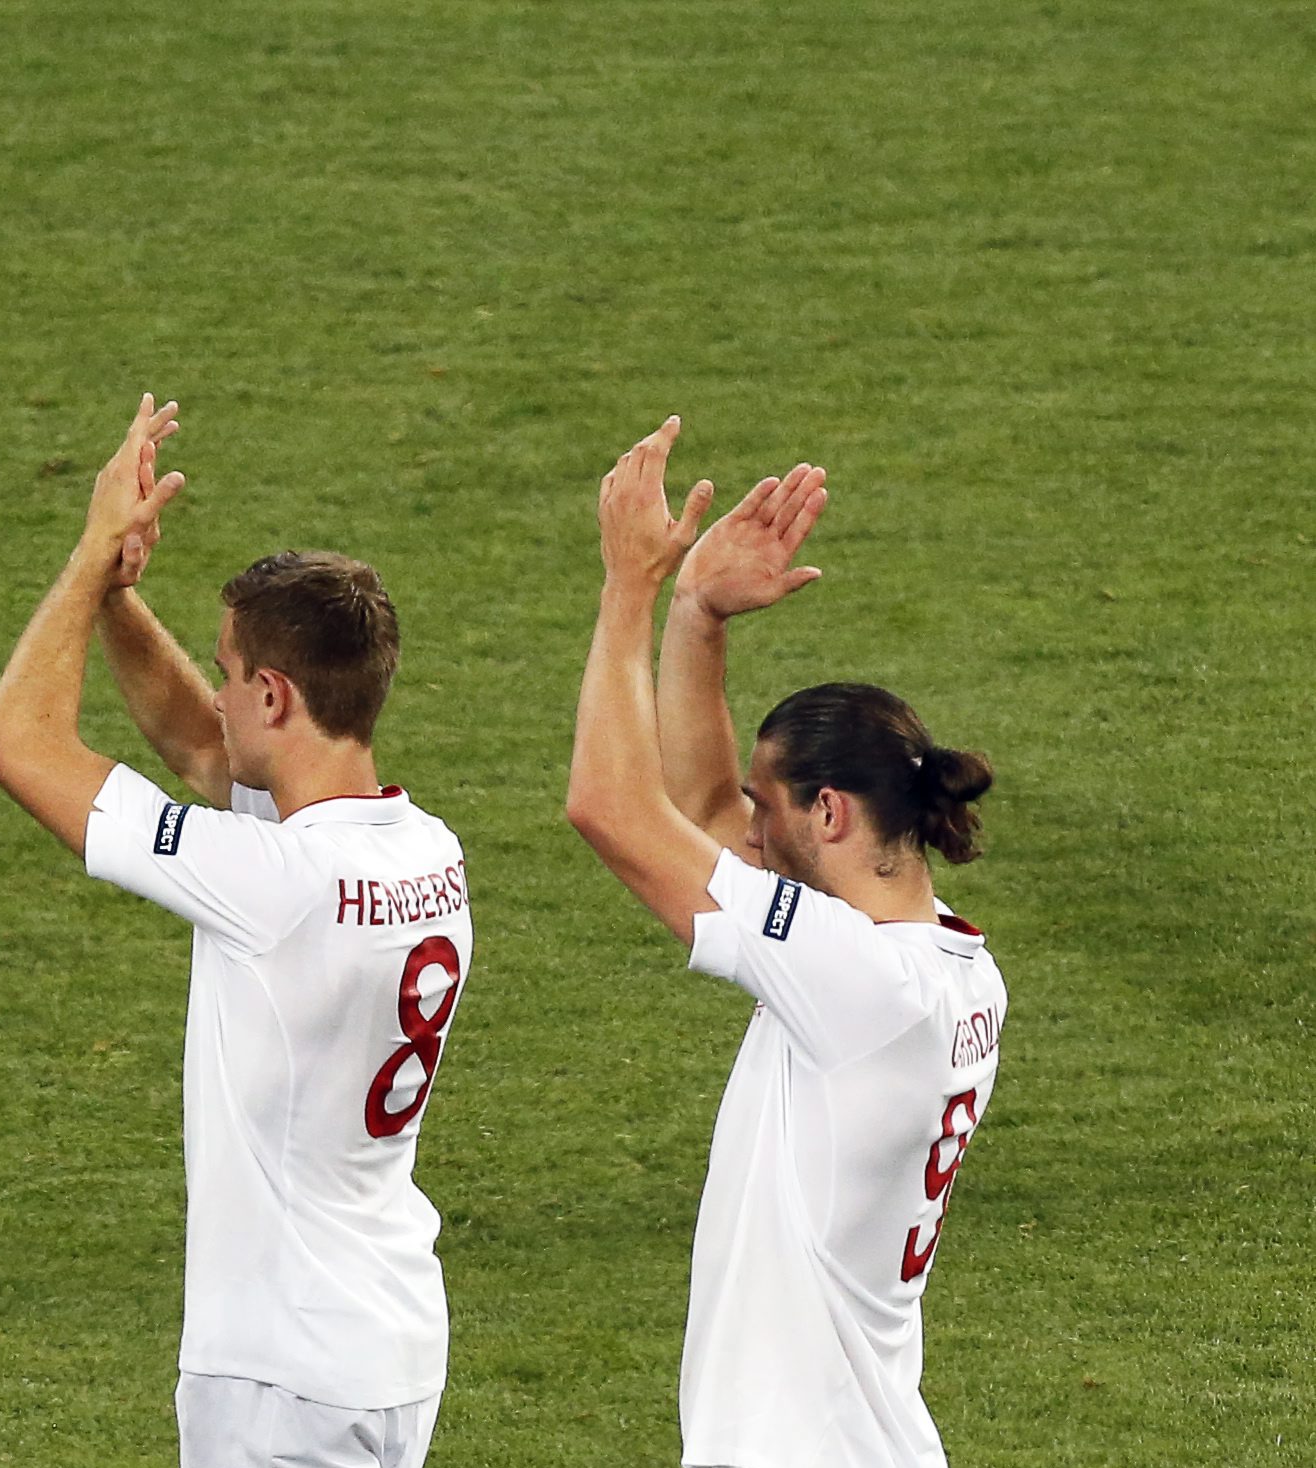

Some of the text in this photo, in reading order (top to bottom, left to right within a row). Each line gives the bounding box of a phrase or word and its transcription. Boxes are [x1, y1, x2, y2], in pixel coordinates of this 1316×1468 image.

[769, 884, 796, 937] RESPECT
[365, 935, 461, 1139] 8
[900, 1086, 978, 1284] 9
